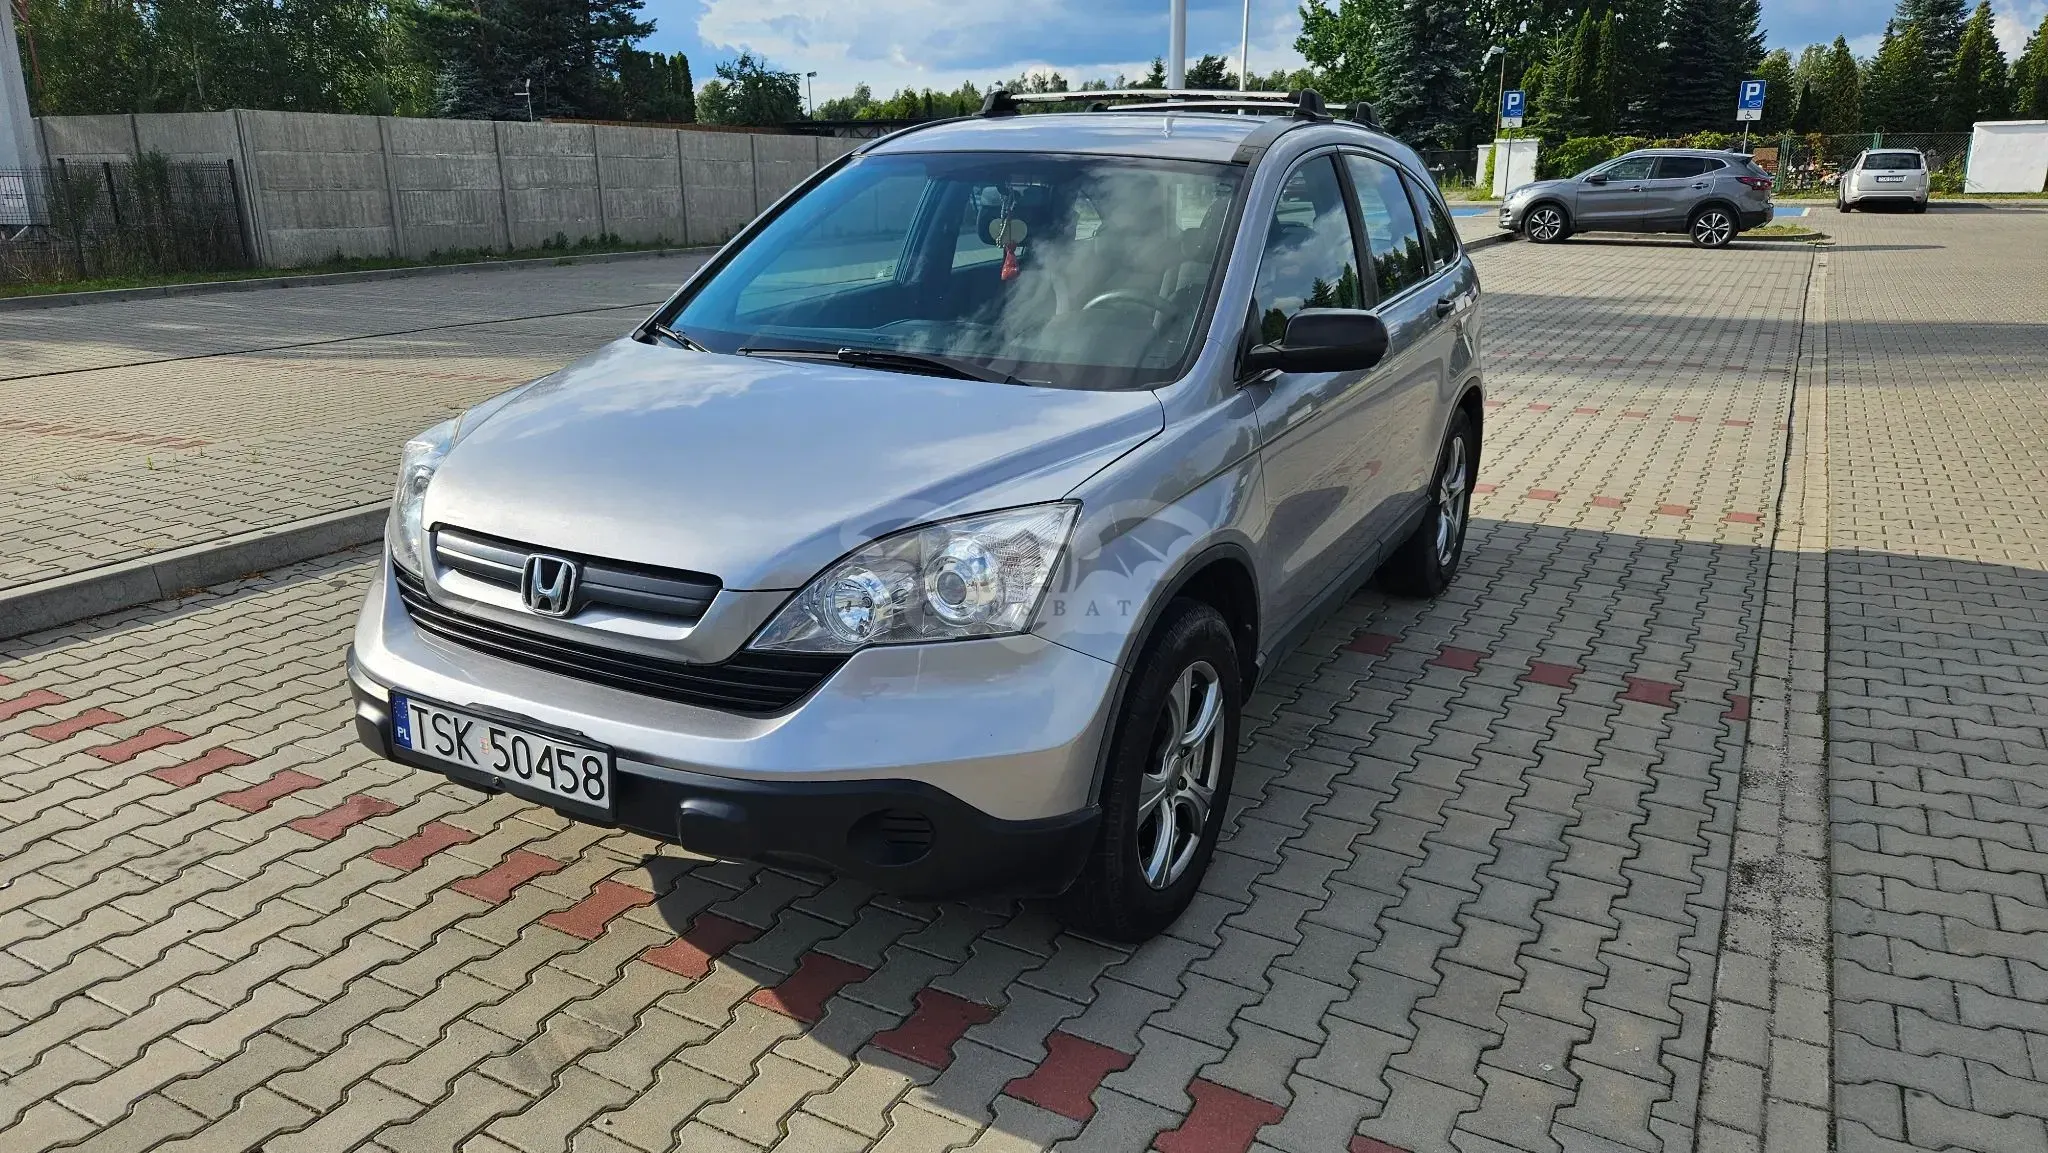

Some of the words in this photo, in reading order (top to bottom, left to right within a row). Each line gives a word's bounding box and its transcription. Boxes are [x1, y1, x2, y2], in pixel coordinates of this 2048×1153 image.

[1745, 83, 1760, 100] P
[1507, 93, 1520, 110] P
[397, 726, 410, 741] PL
[410, 703, 479, 765] TSK
[488, 726, 605, 801] 50458
